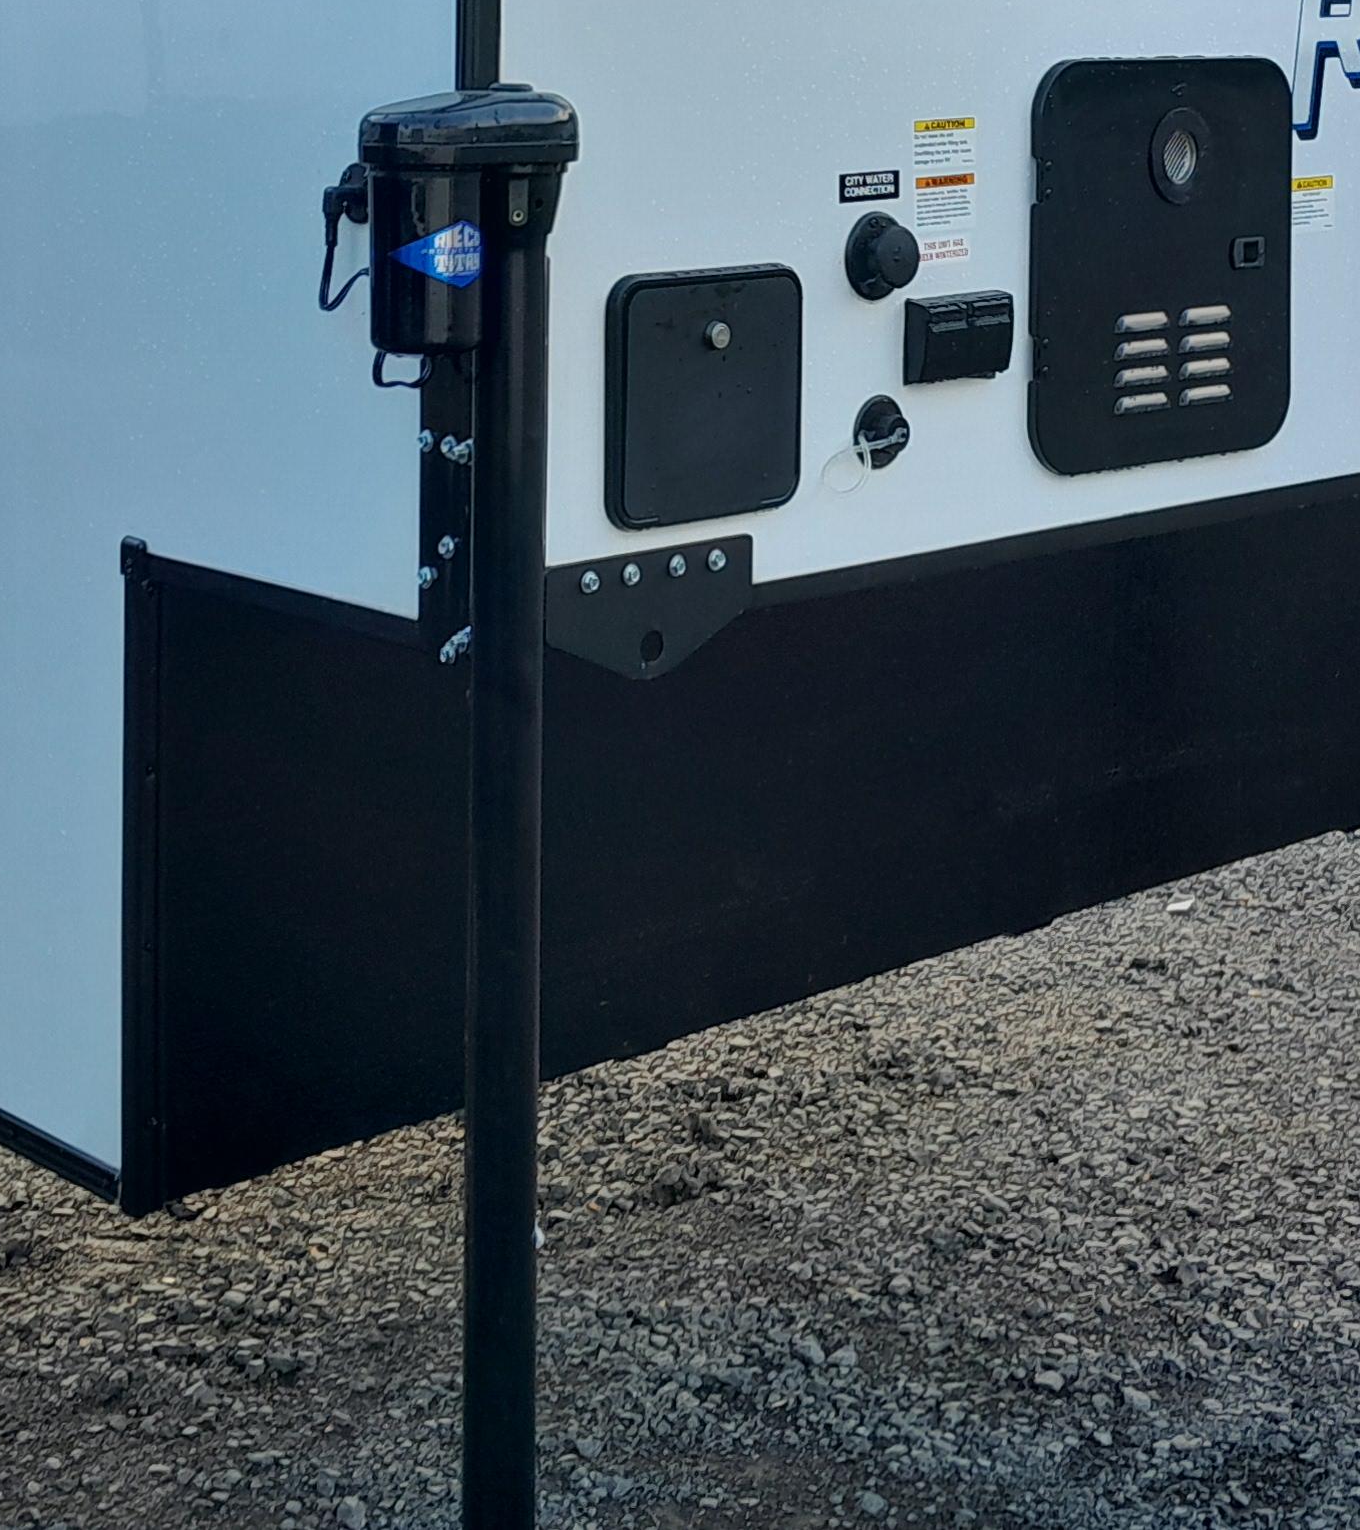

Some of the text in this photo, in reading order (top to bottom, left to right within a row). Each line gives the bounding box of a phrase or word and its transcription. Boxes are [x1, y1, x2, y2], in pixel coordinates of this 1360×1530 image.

[931, 120, 966, 130] CAUTION
[845, 174, 895, 186] CITY WATER
[844, 185, 895, 198] CONNECTION
